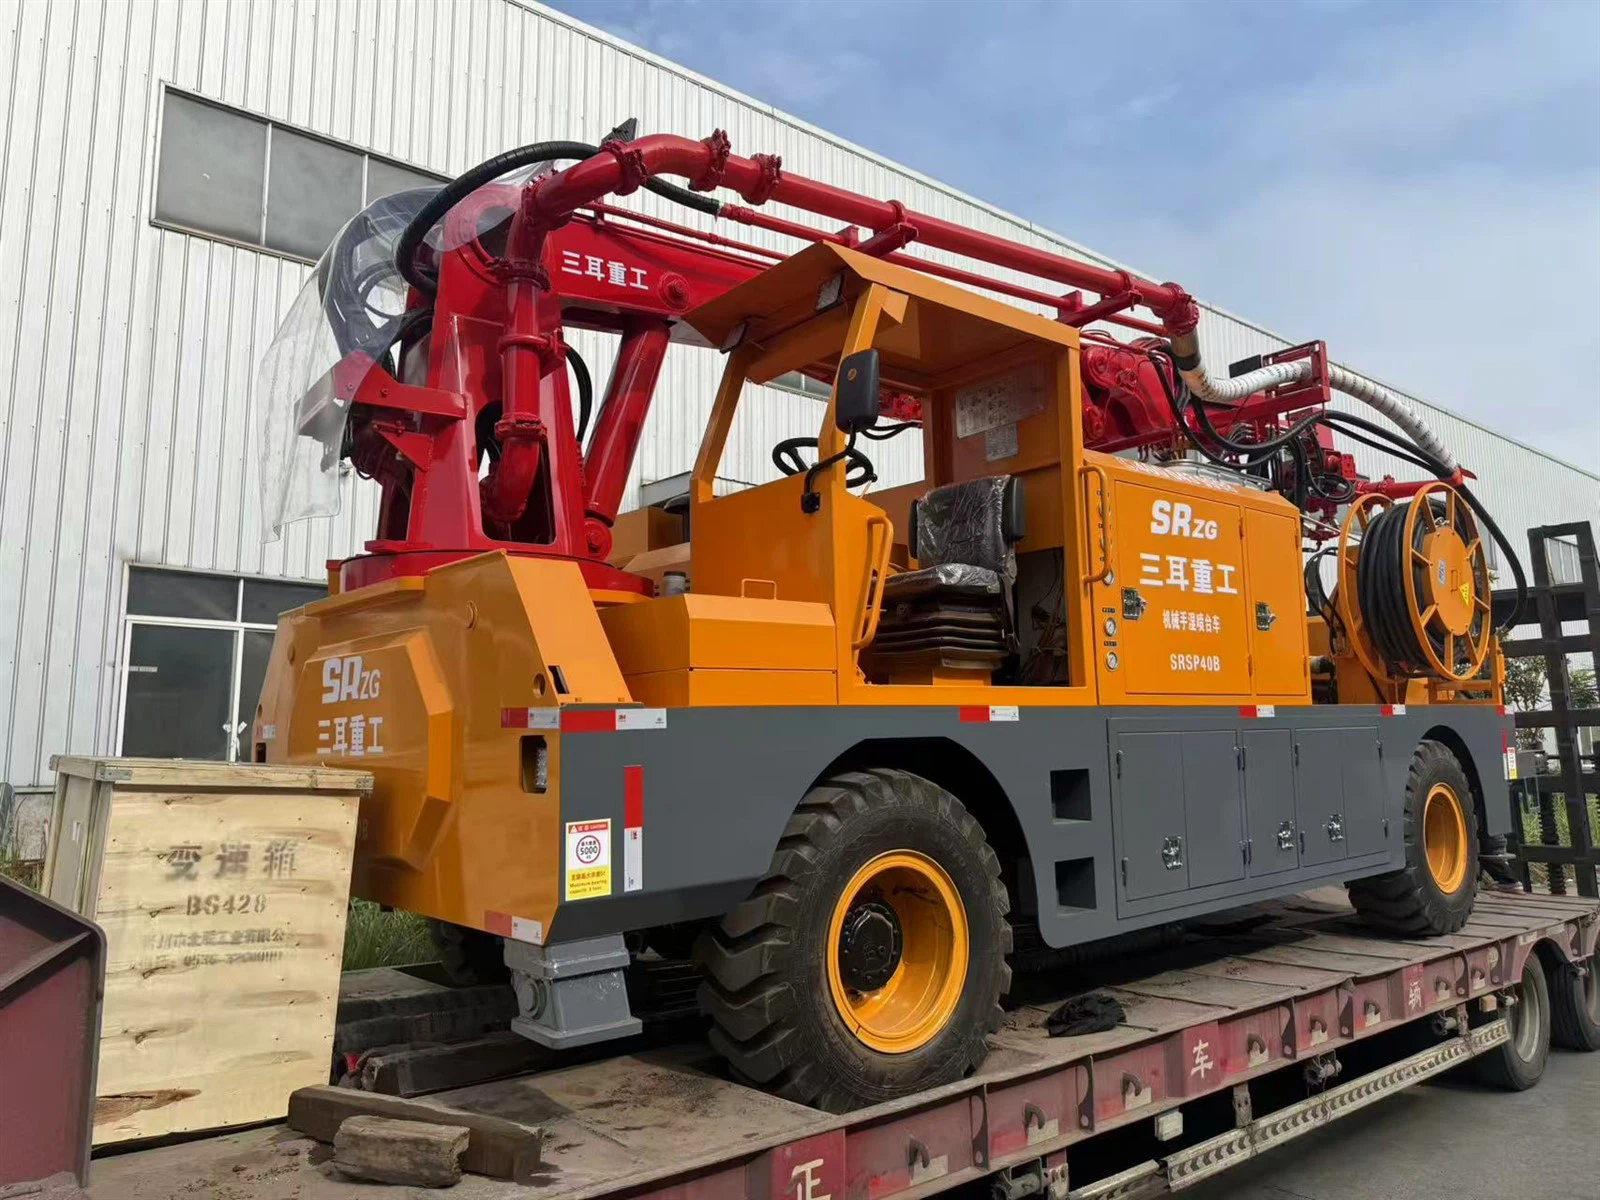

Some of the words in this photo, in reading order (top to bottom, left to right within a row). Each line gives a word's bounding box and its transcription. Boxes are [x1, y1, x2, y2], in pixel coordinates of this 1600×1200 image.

[561, 250, 649, 290] 三耳重工
[1139, 552, 1238, 595] 三耳重工
[1169, 653, 1221, 672] SRSP40B
[316, 714, 384, 757] 三耳重工
[580, 845, 598, 856] 5000
[186, 894, 267, 916] BS428
[1190, 1038, 1214, 1079] 车
